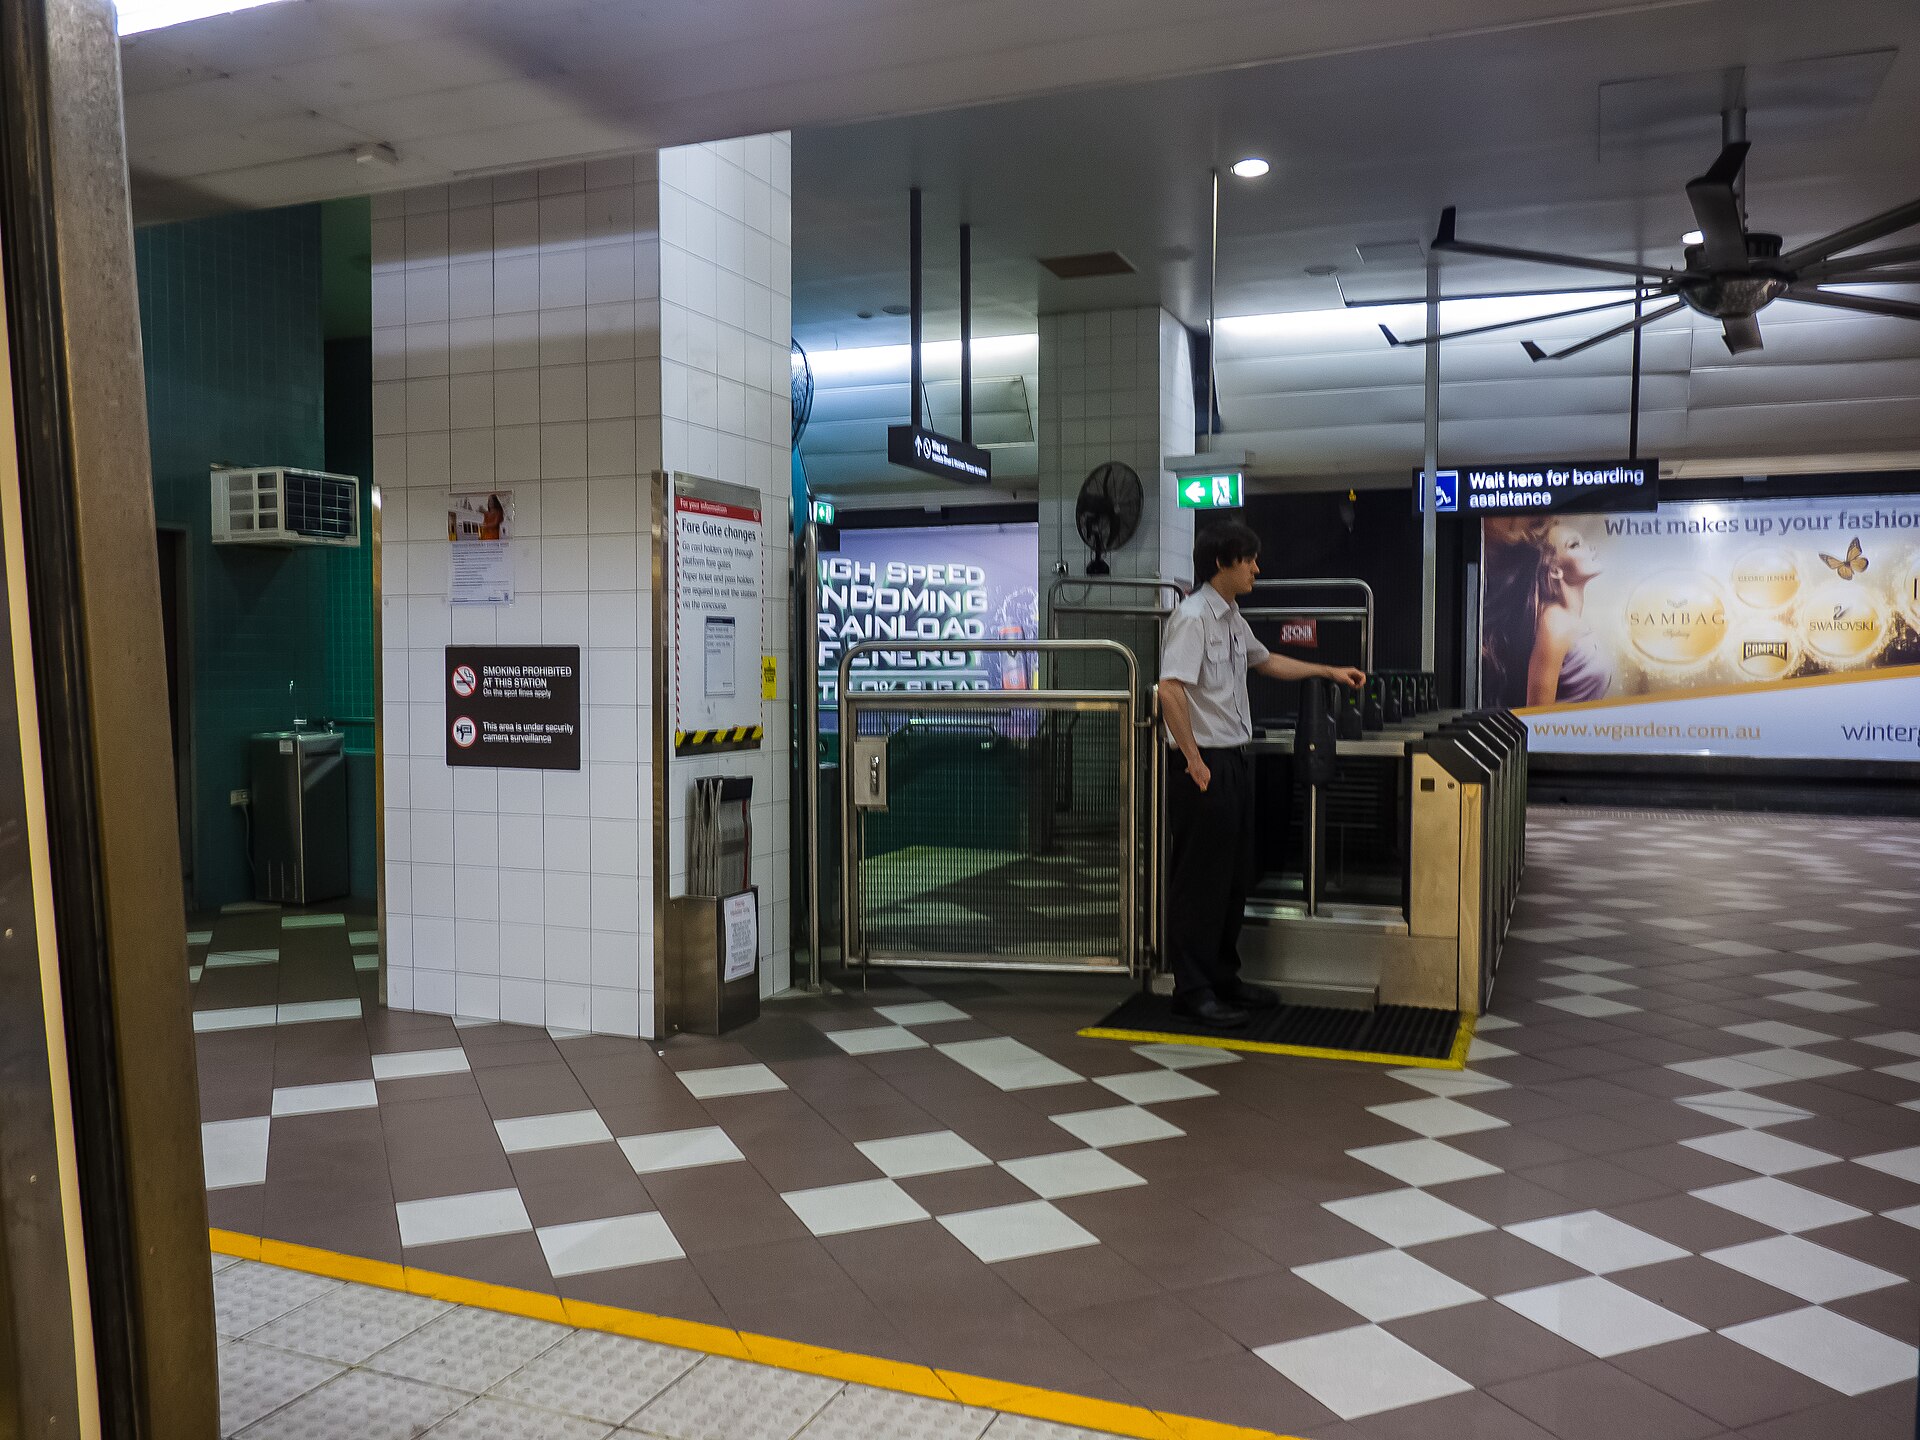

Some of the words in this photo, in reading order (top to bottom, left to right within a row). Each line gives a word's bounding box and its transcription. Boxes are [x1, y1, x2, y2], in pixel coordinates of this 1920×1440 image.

[1470, 471, 1505, 490] Wait
[1508, 470, 1543, 488] here
[1547, 470, 1570, 486] for
[1574, 467, 1644, 486] boarding
[689, 501, 700, 510] your
[1469, 490, 1552, 508] assistance
[682, 518, 700, 532] Fare
[702, 521, 722, 538] Gate
[724, 524, 756, 544] changes
[1604, 516, 1662, 536] What
[1667, 517, 1738, 534] makes
[1745, 517, 1772, 536] up
[1778, 516, 1832, 536] your
[822, 558, 876, 583] IGH
[887, 562, 985, 586] SPEED
[817, 613, 985, 640] RAINLOAD
[1630, 612, 1724, 625] SAMBAG
[1810, 620, 1874, 631] SWAROVSKI
[1744, 642, 1785, 658] CAMPER
[483, 666, 520, 677] SMOKING
[522, 666, 572, 678] PROHIBITED
[483, 678, 492, 688] AT
[495, 678, 512, 688] THIS
[514, 678, 547, 689] STATION
[483, 688, 492, 697] On
[493, 688, 503, 697] the
[483, 722, 497, 732] This
[499, 723, 514, 732] area
[516, 722, 522, 732] is
[524, 722, 544, 733] under
[546, 723, 574, 735] security
[1534, 722, 1760, 742] www.wgarden.com.au
[1841, 721, 1920, 748] winter
[483, 734, 508, 743] camera
[510, 733, 552, 744] surveillance
